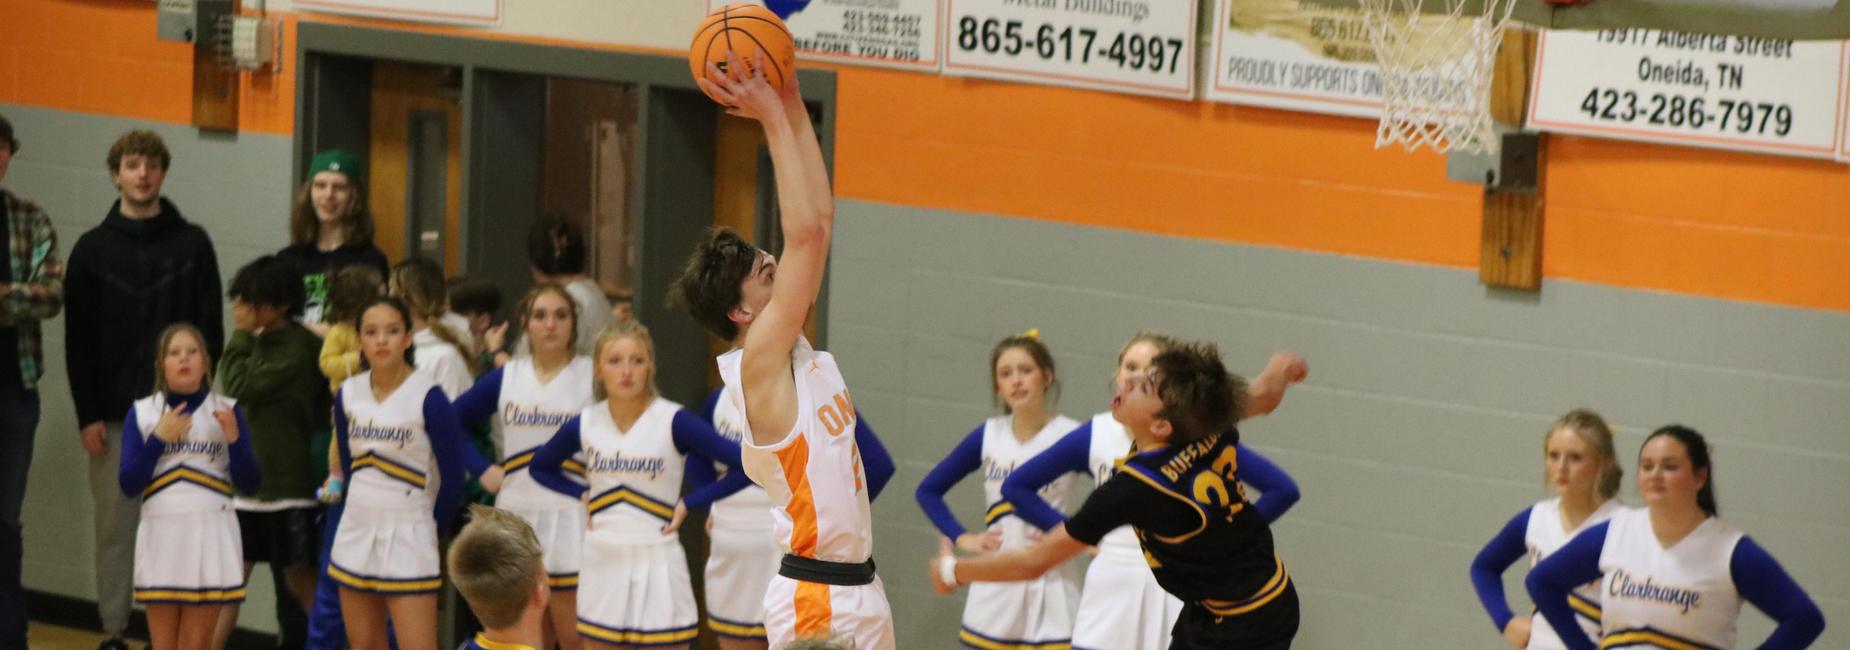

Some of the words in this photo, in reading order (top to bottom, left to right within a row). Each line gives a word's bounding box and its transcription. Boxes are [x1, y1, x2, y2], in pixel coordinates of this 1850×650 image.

[1064, 0, 1150, 22] Buildings
[858, 46, 888, 60] YOU
[958, 16, 1183, 74] 865-617-4997
[1657, 30, 1726, 52] Alberta
[1733, 36, 1793, 59] Street
[1228, 55, 1289, 87] PROUDLY
[1291, 62, 1359, 94] SUPPORTS
[1637, 56, 1710, 93] Oneida,
[1717, 63, 1744, 91] TN
[1580, 87, 1793, 137] 423-286-7979
[587, 447, 665, 480] Clarkrange
[1609, 568, 1700, 615] Clarkrange
